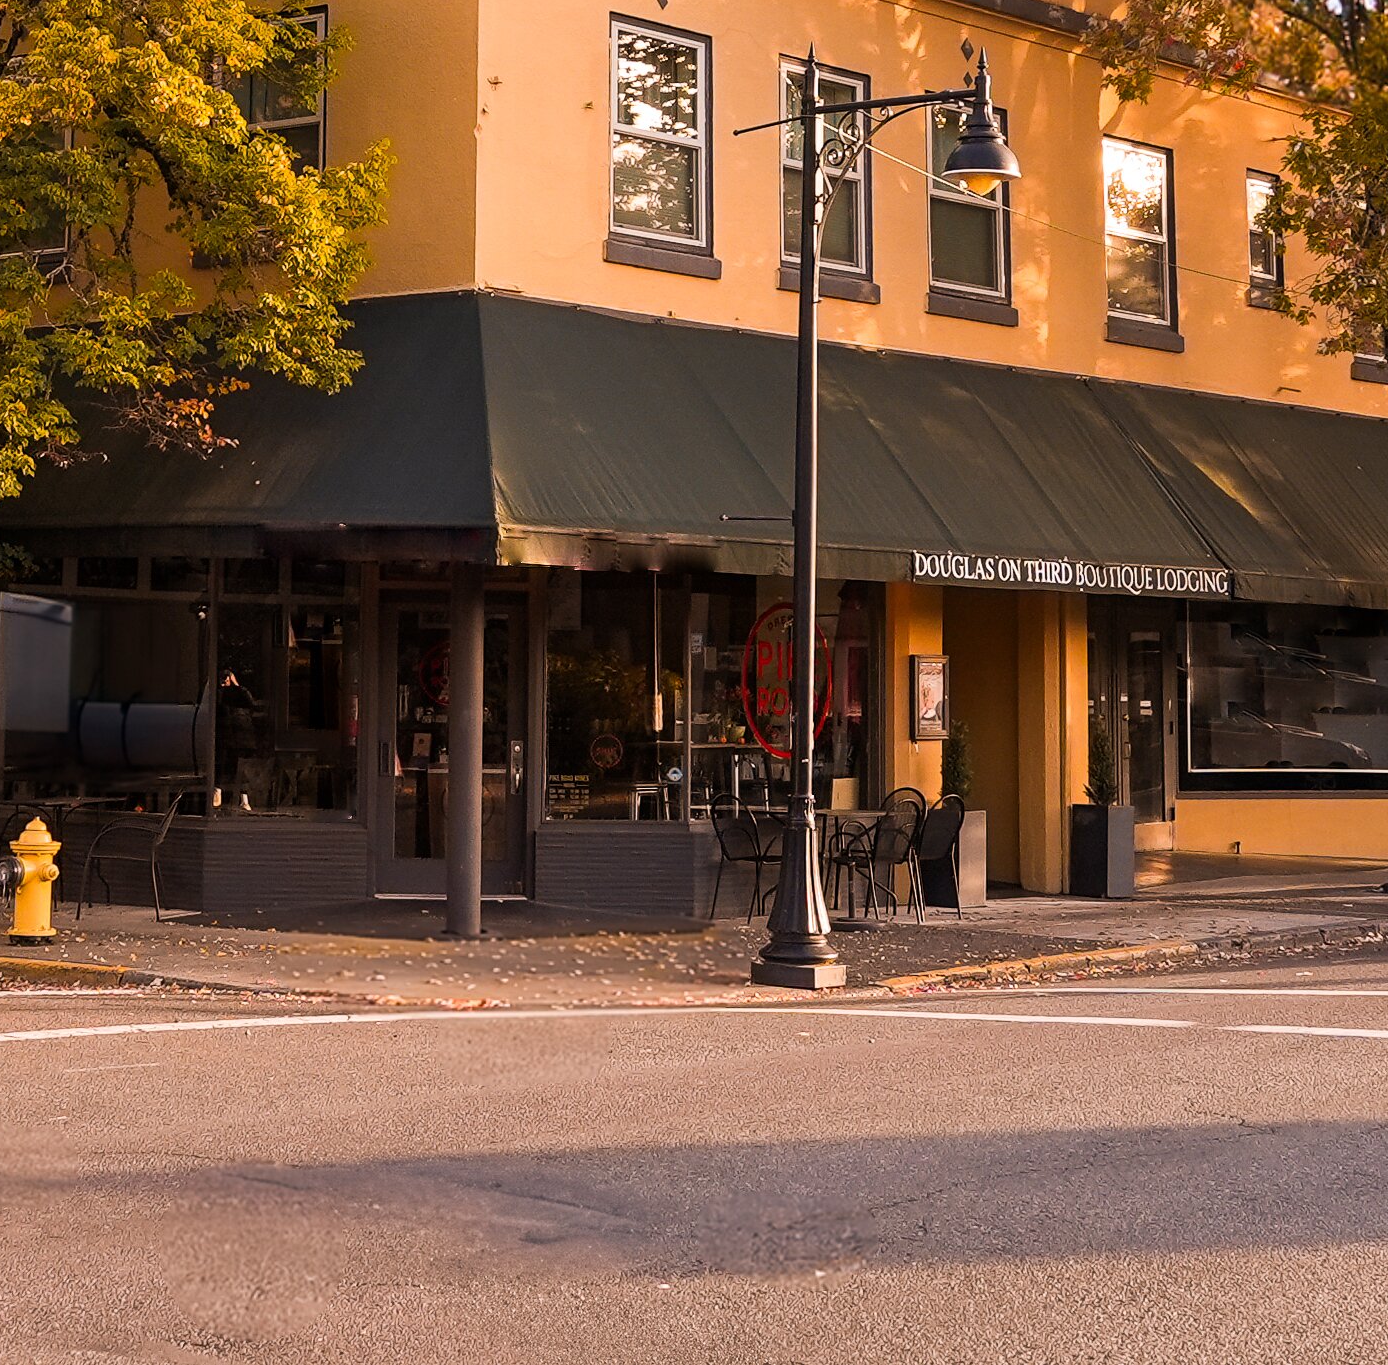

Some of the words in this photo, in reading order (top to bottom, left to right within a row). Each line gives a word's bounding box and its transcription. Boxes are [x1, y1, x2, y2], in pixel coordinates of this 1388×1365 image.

[914, 552, 995, 581] DOUGLAS
[998, 557, 1022, 582] ON
[1024, 559, 1073, 585] THIRD
[1075, 563, 1154, 596] BOUTIQUE
[1156, 569, 1228, 594] LODGING
